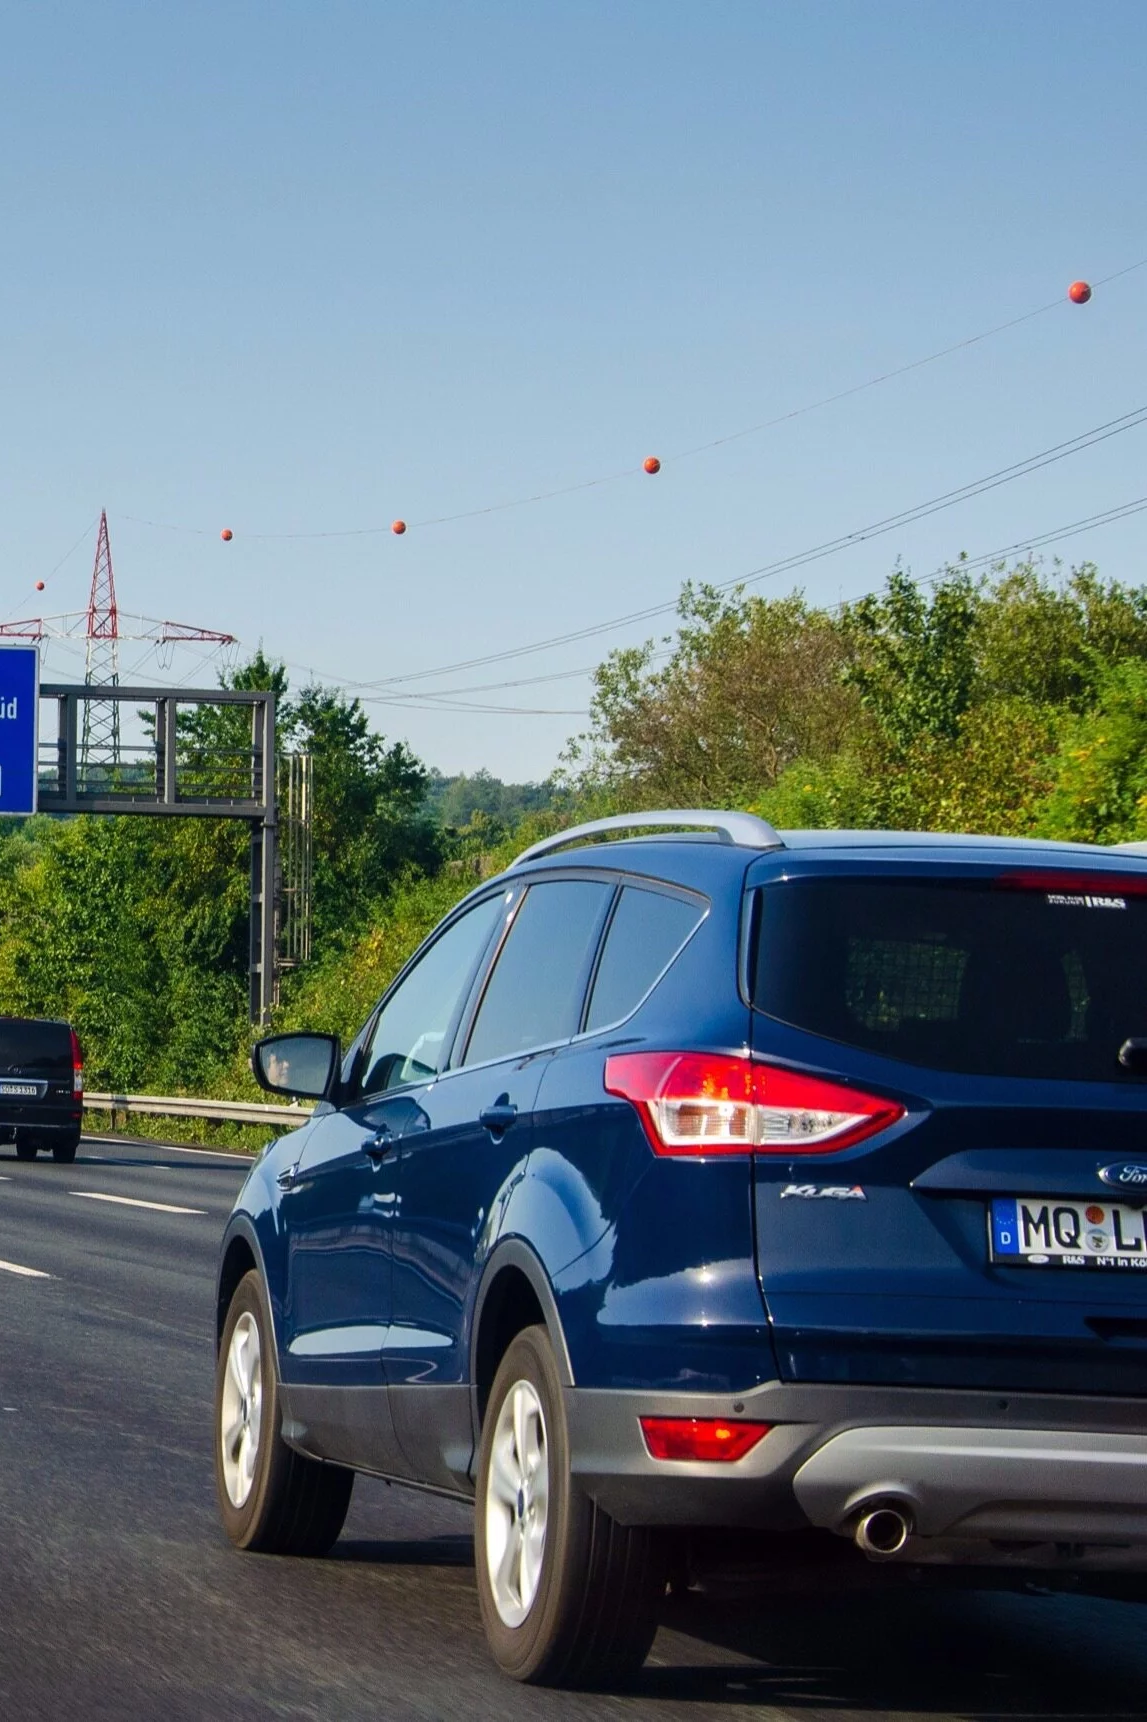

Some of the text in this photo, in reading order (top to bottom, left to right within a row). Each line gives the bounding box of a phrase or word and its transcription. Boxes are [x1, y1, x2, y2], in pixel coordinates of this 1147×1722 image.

[1092, 896, 1126, 909] R&S
[1022, 1204, 1083, 1248] MQ
[1001, 1232, 1011, 1245] D
